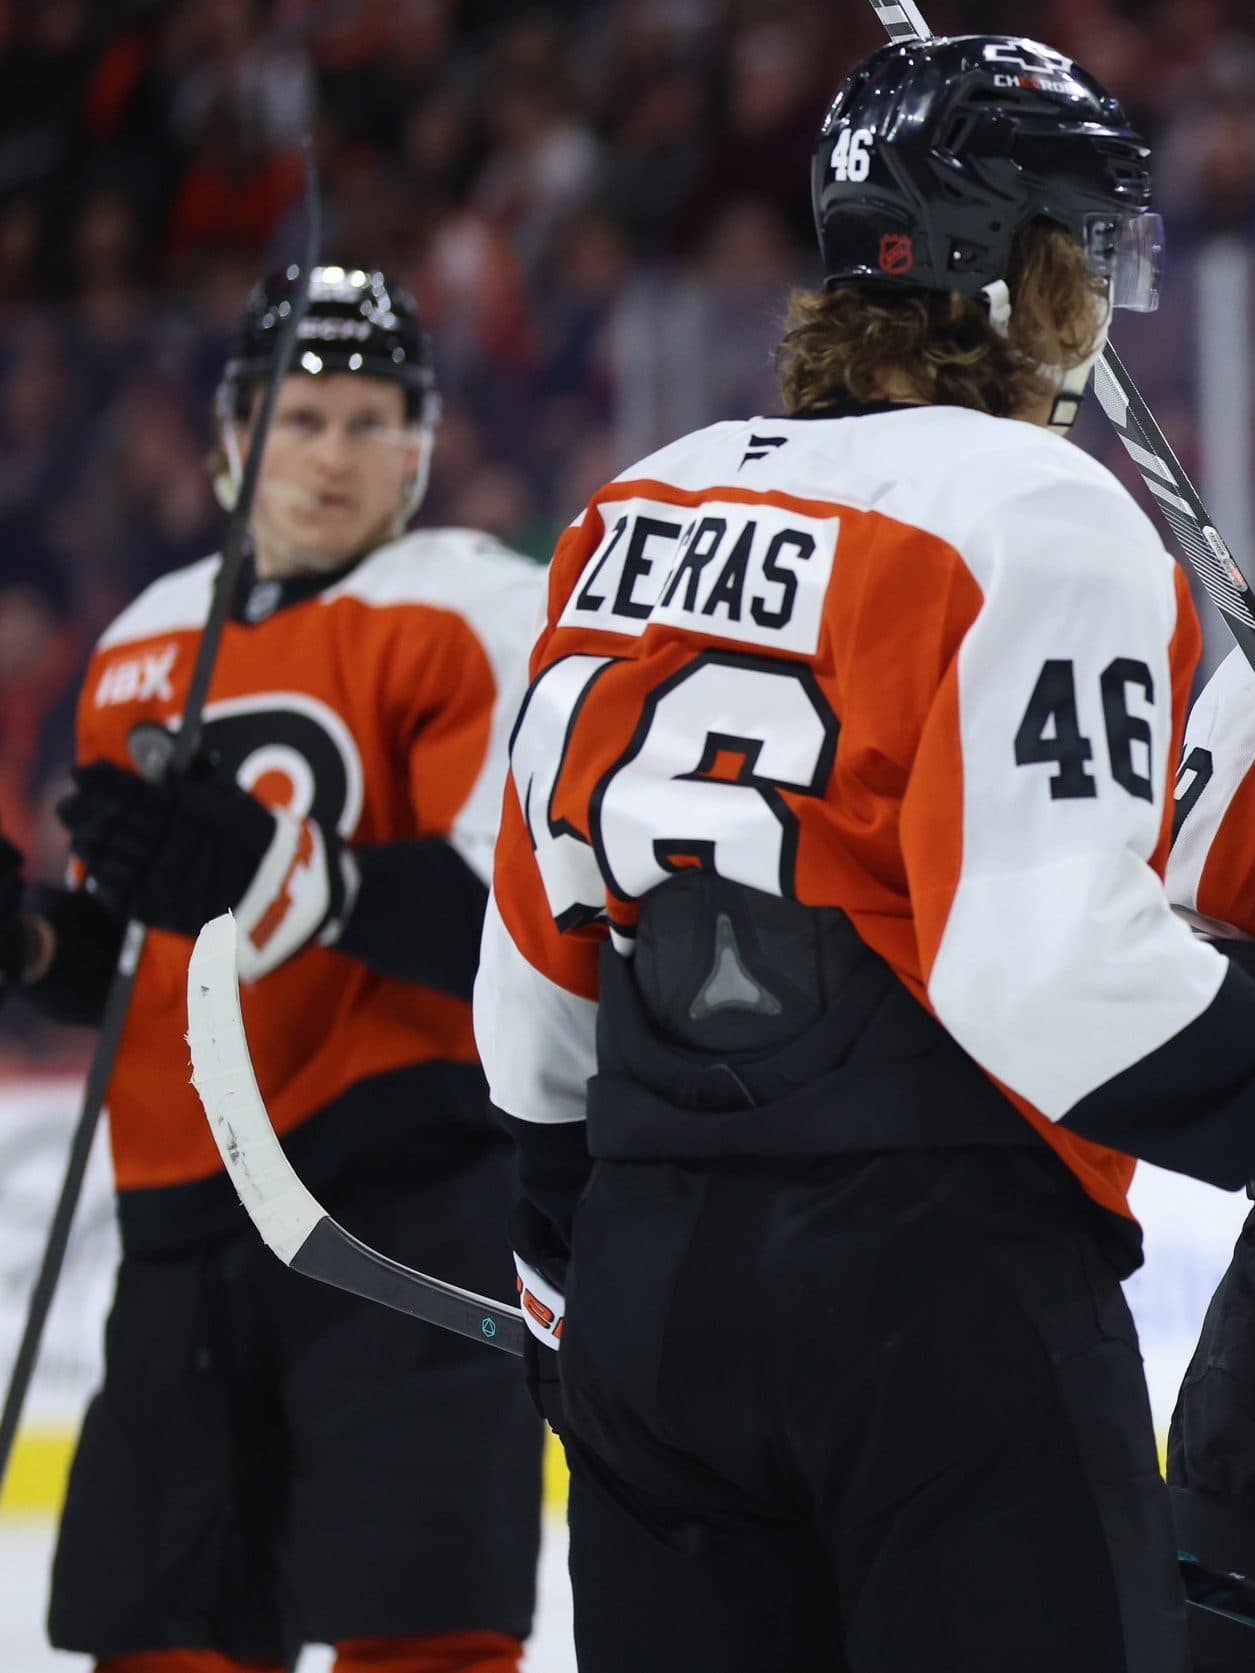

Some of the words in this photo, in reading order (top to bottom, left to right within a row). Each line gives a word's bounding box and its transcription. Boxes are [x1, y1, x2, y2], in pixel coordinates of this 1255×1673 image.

[831, 128, 874, 182] 46
[575, 514, 816, 630] ZERAS
[1014, 657, 1154, 804] 46
